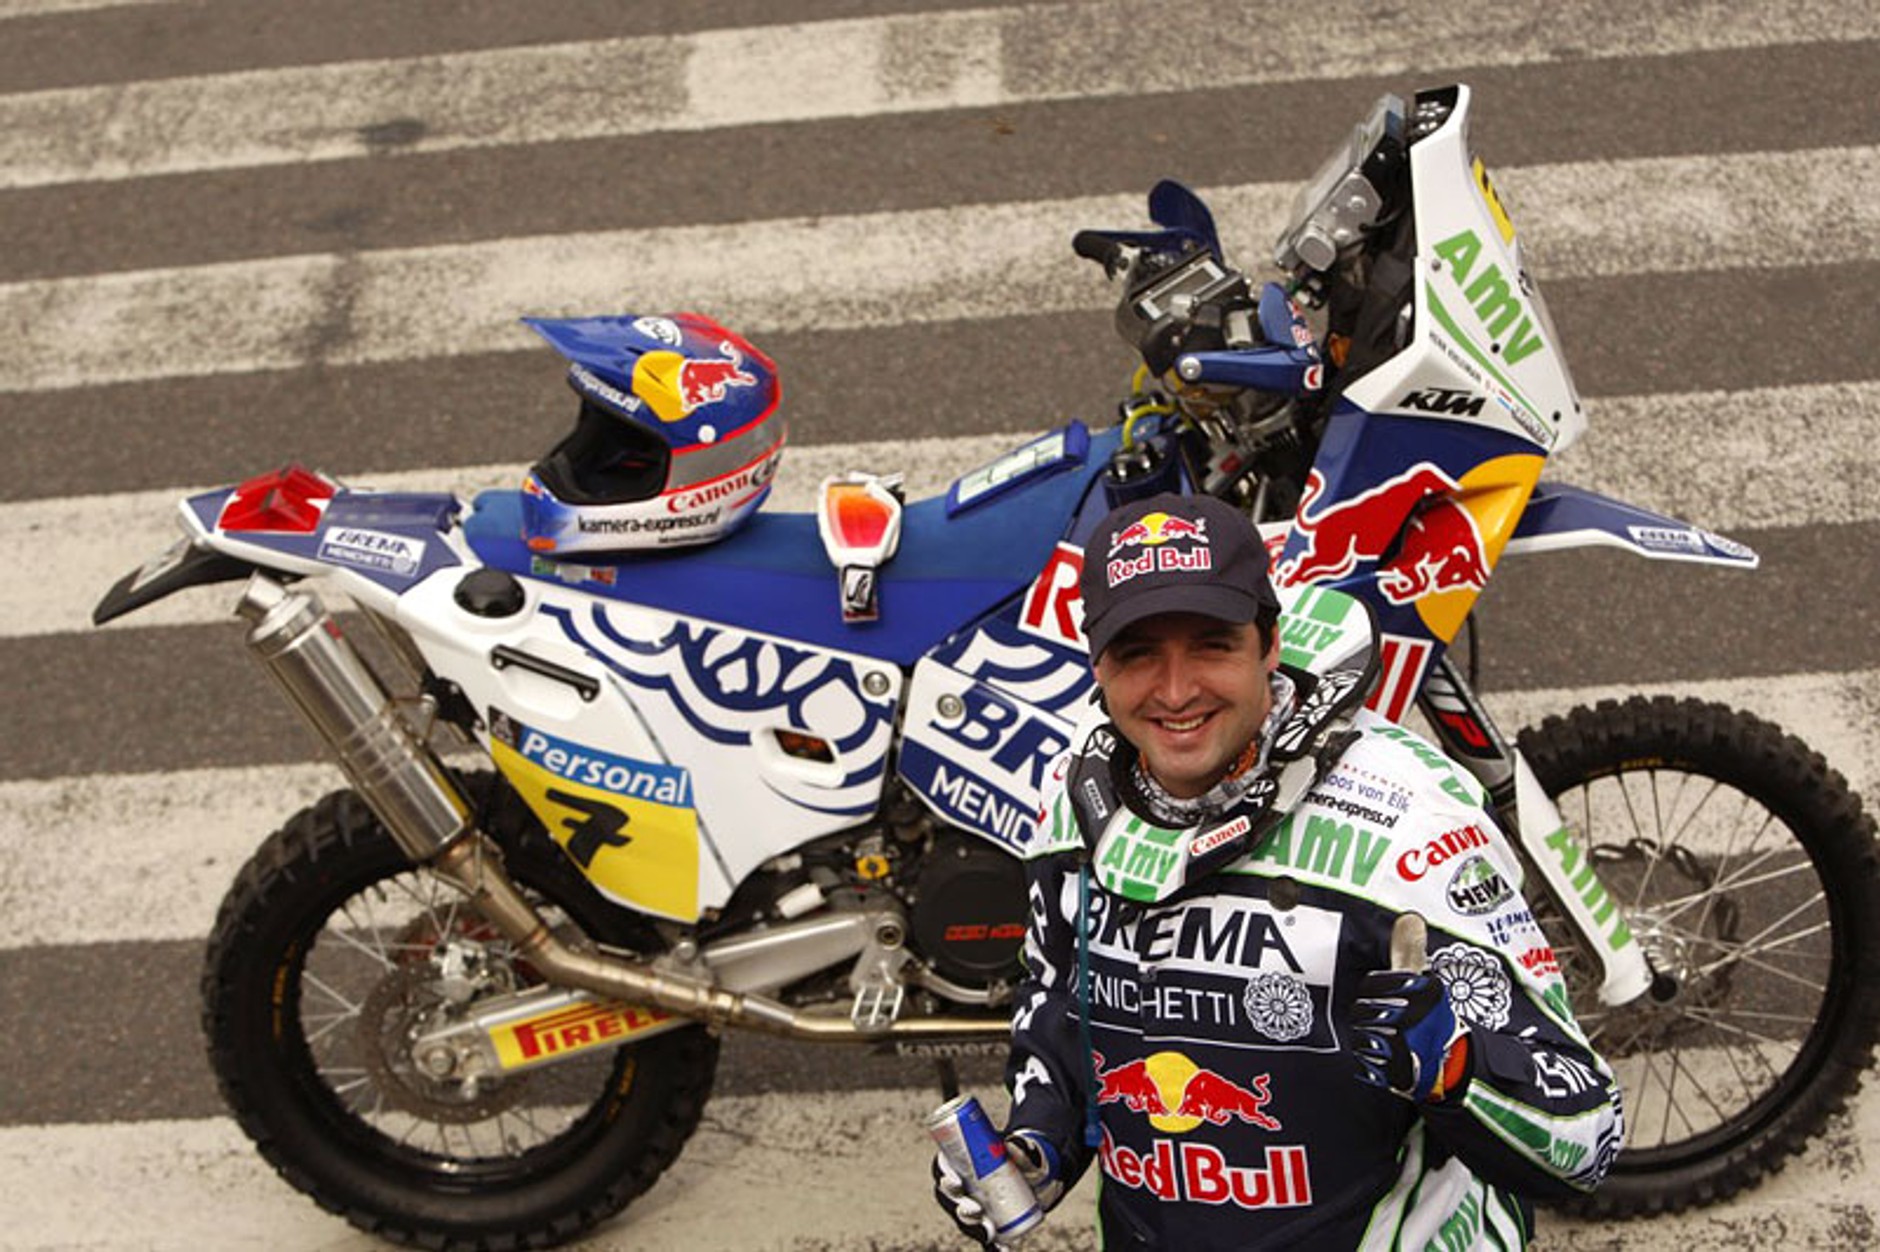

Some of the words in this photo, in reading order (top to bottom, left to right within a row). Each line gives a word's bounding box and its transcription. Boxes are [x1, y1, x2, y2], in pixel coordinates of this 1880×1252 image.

[1398, 387, 1487, 417] KTM
[667, 474, 749, 514] Canon
[577, 507, 722, 533] kamera-express.nl
[1107, 549, 1153, 588] Red
[1157, 547, 1212, 572] Bull
[521, 731, 689, 804] Personal
[545, 788, 633, 869] 7
[1302, 791, 1400, 829] mera-express.nl
[1191, 820, 1248, 854] Canon
[1072, 887, 1304, 974] BREMA
[1066, 962, 1236, 1026] NICHETTI
[513, 1001, 674, 1060] PIRELL
[1180, 1142, 1313, 1209] Bull
